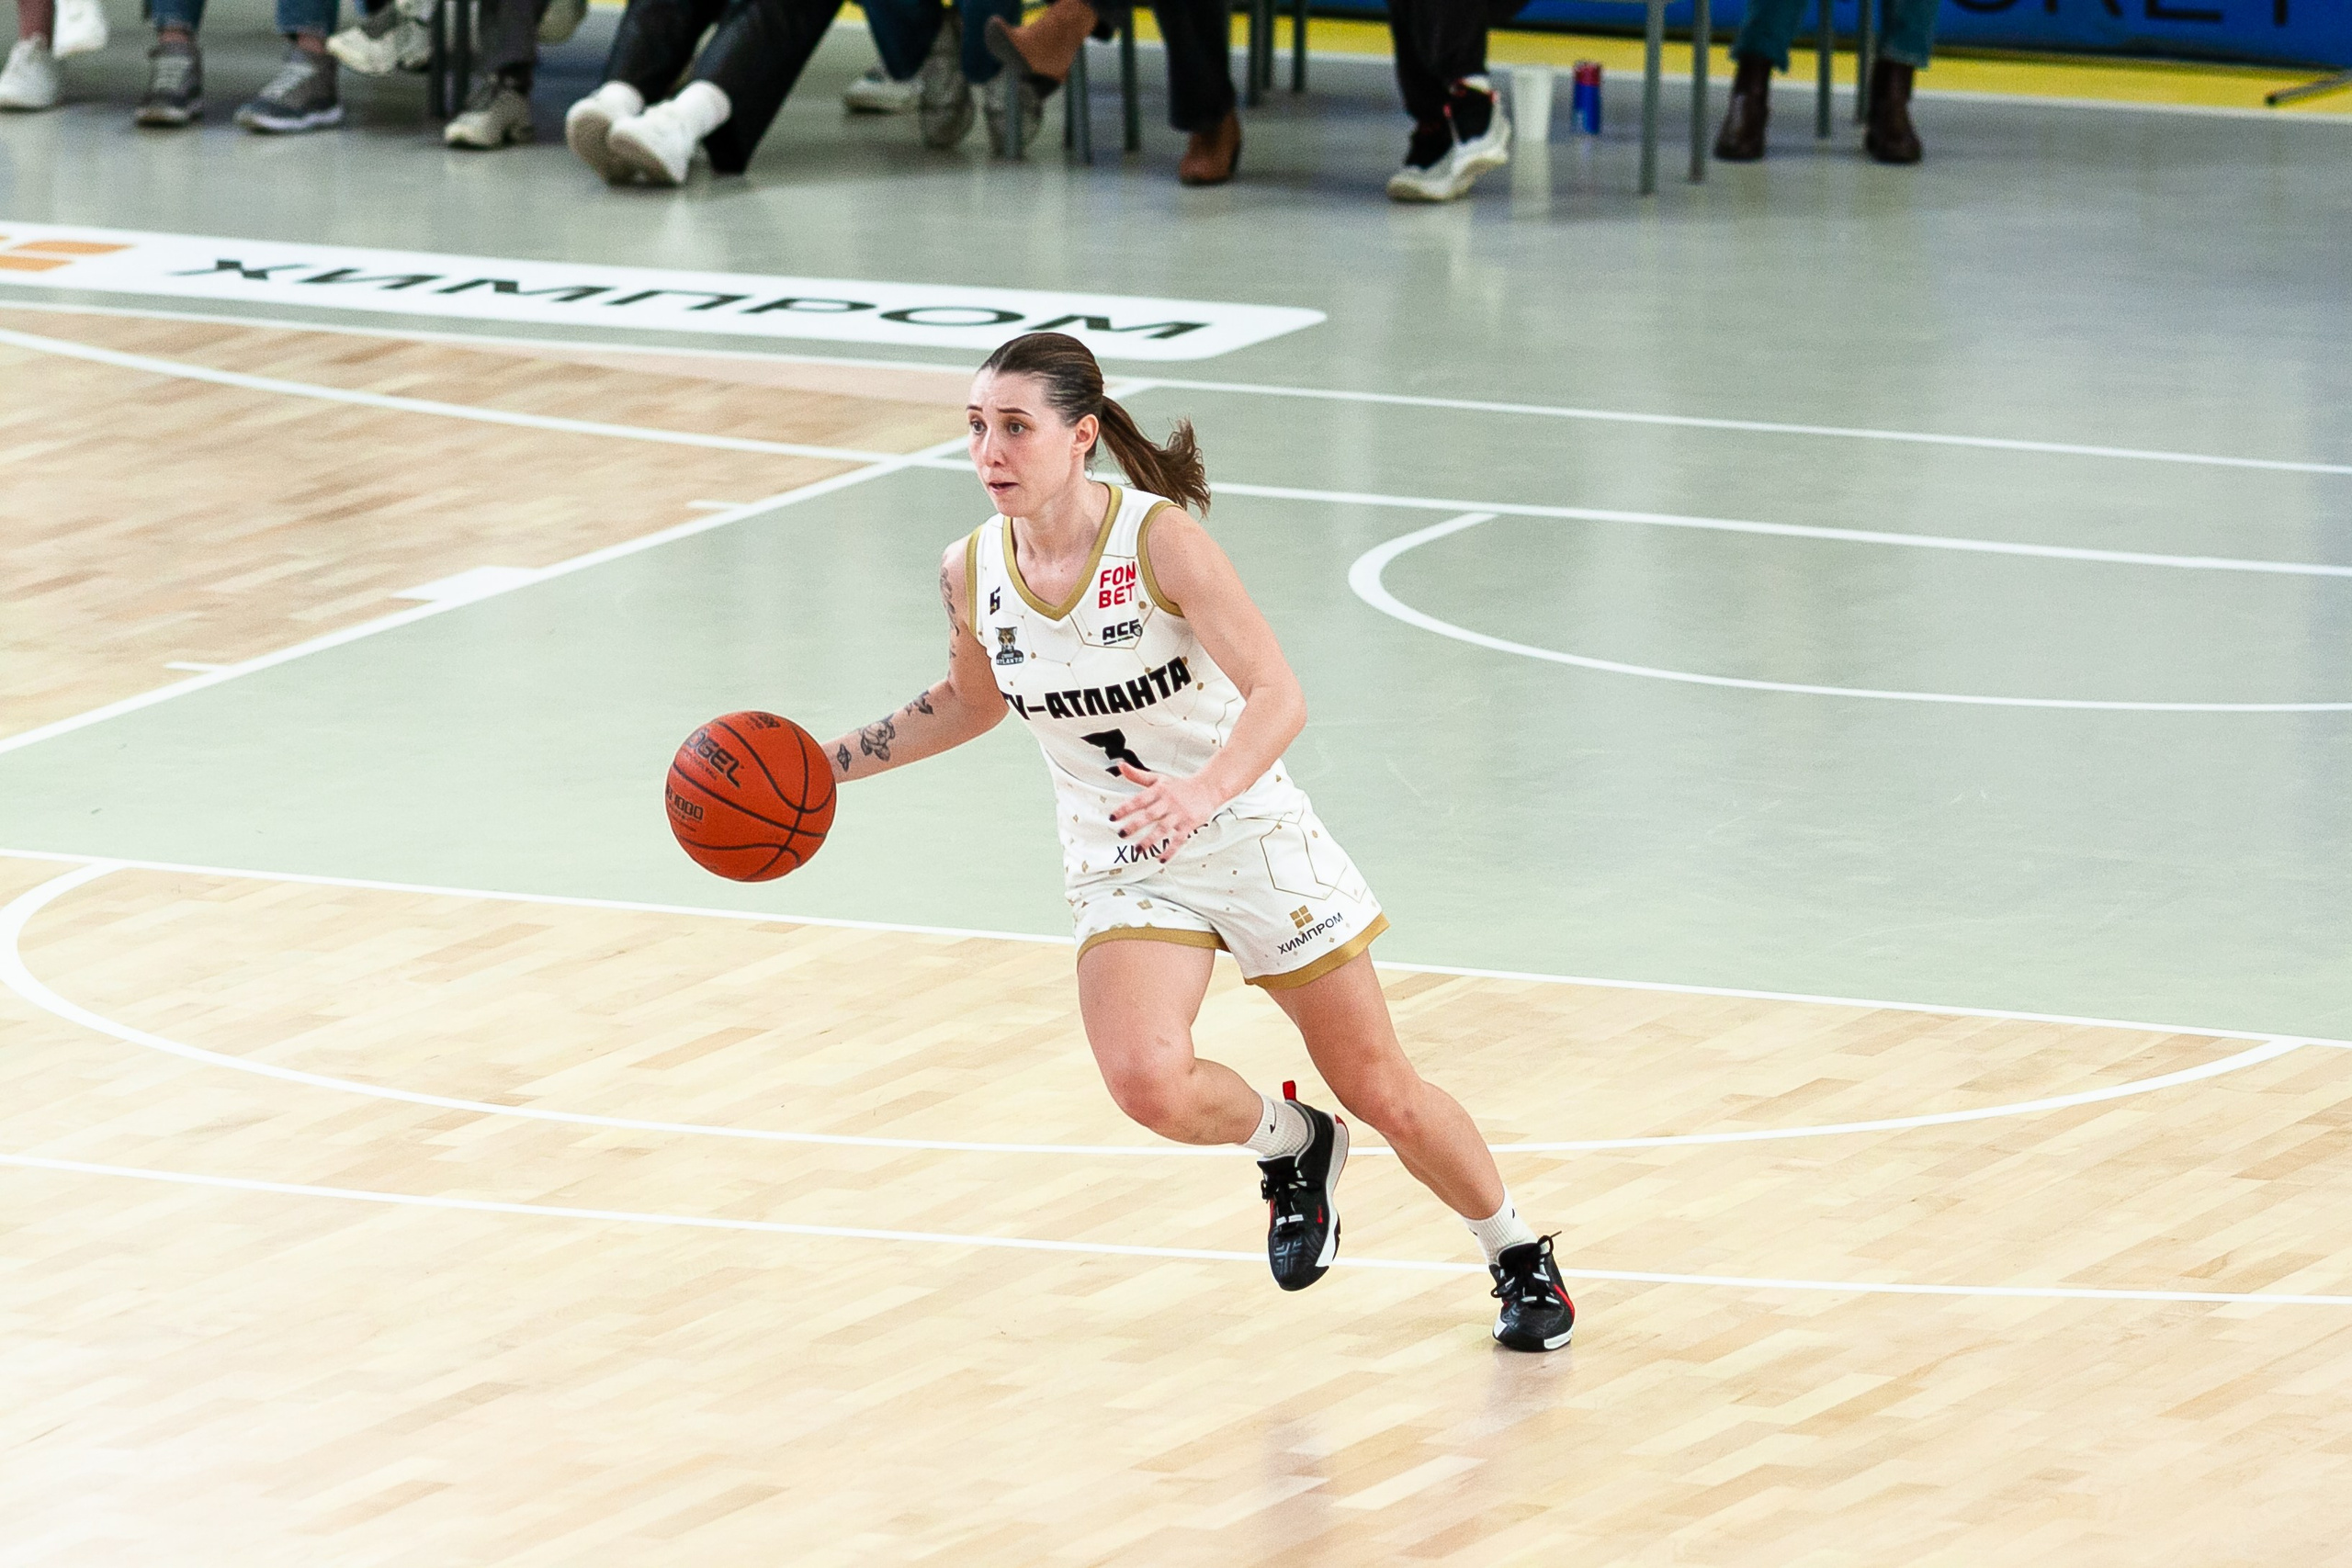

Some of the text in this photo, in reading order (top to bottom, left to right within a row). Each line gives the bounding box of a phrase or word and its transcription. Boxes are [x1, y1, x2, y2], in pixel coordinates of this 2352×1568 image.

[169, 258, 1209, 341] ХИМПРОМ
[1100, 561, 1136, 589] FON
[1098, 582, 1136, 609] BET
[1277, 912, 1344, 955] ХИМПРОМ
